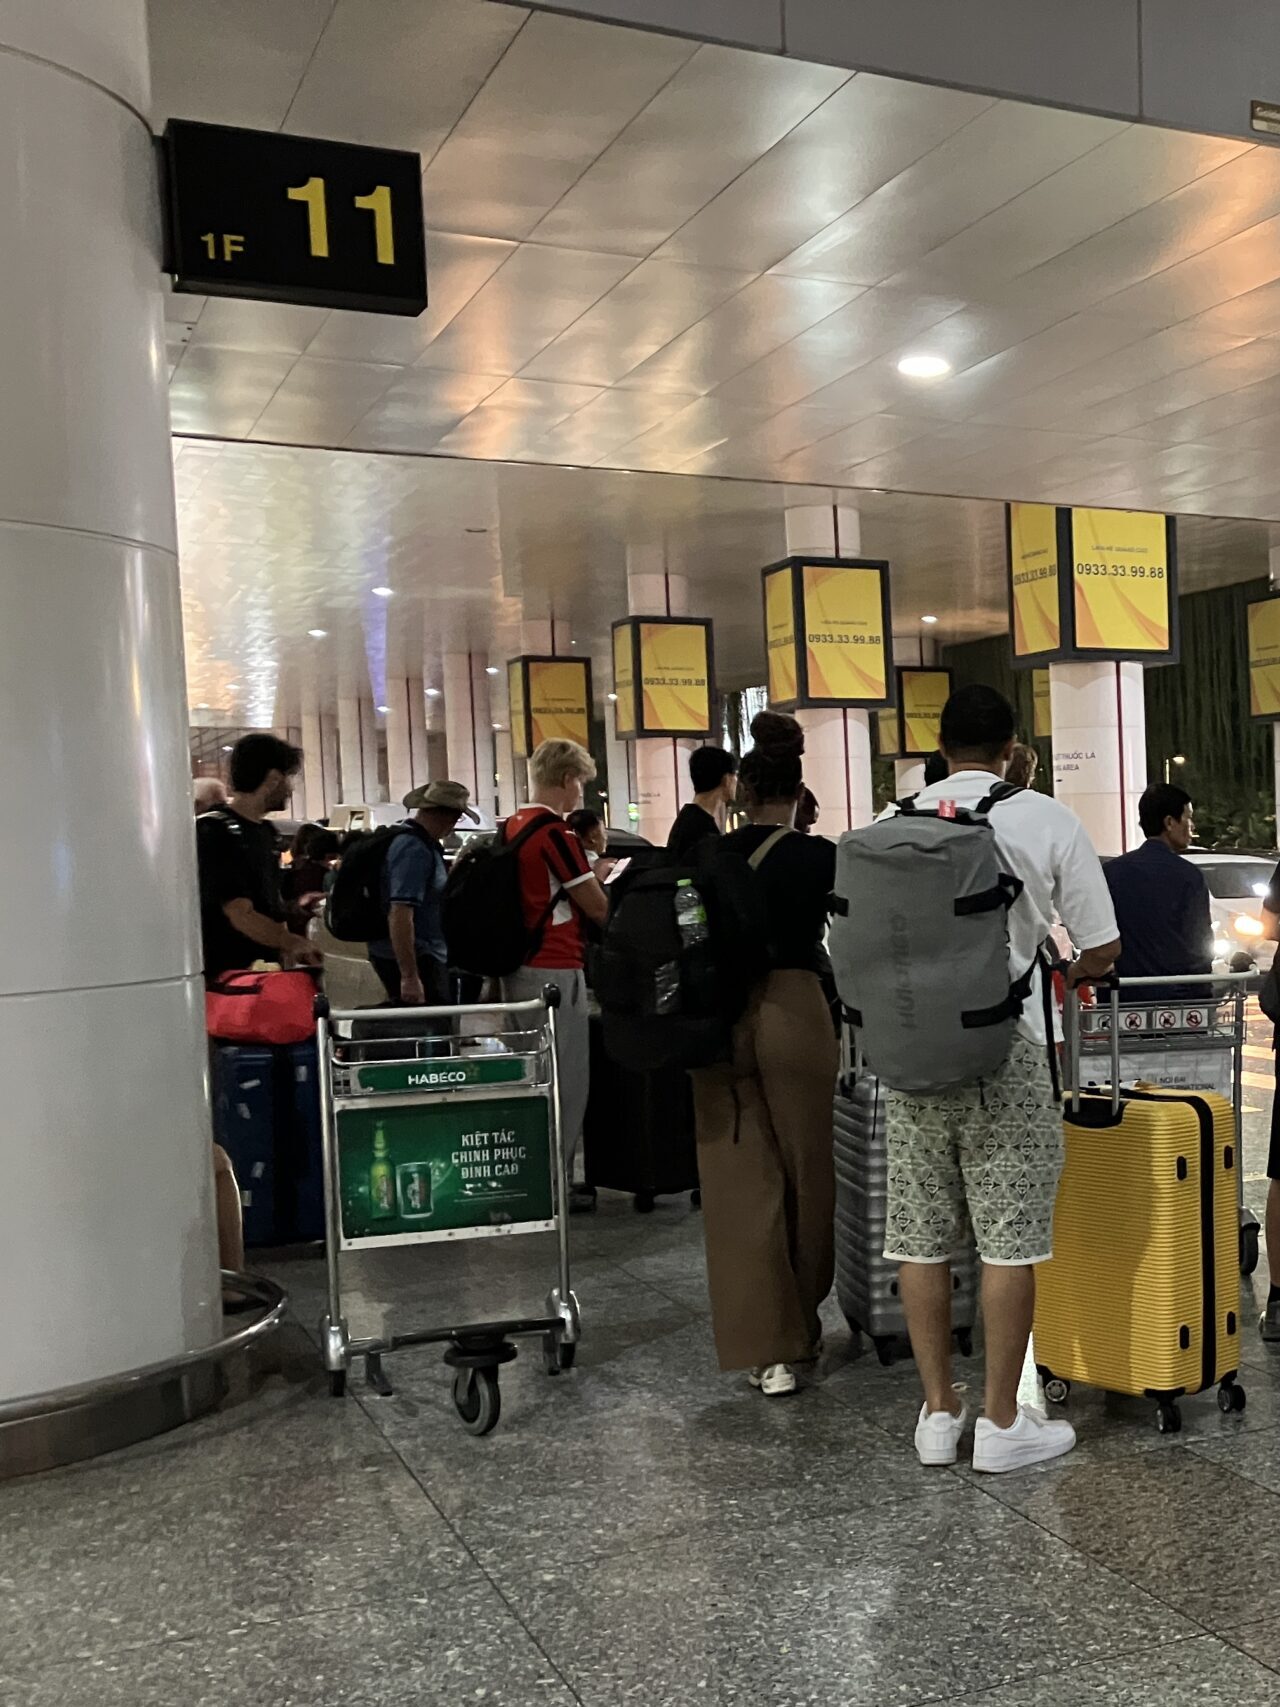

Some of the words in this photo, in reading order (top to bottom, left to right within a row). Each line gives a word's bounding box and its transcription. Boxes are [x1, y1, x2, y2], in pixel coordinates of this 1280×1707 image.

[287, 177, 394, 264] 11
[201, 233, 245, 261] 1F
[1077, 563, 1164, 578] 0933.33.99.88
[808, 633, 881, 645] 0933.33.99.88
[408, 1071, 466, 1085] HABECO
[462, 1131, 489, 1148] KIỆT
[494, 1163, 519, 1176] CAO
